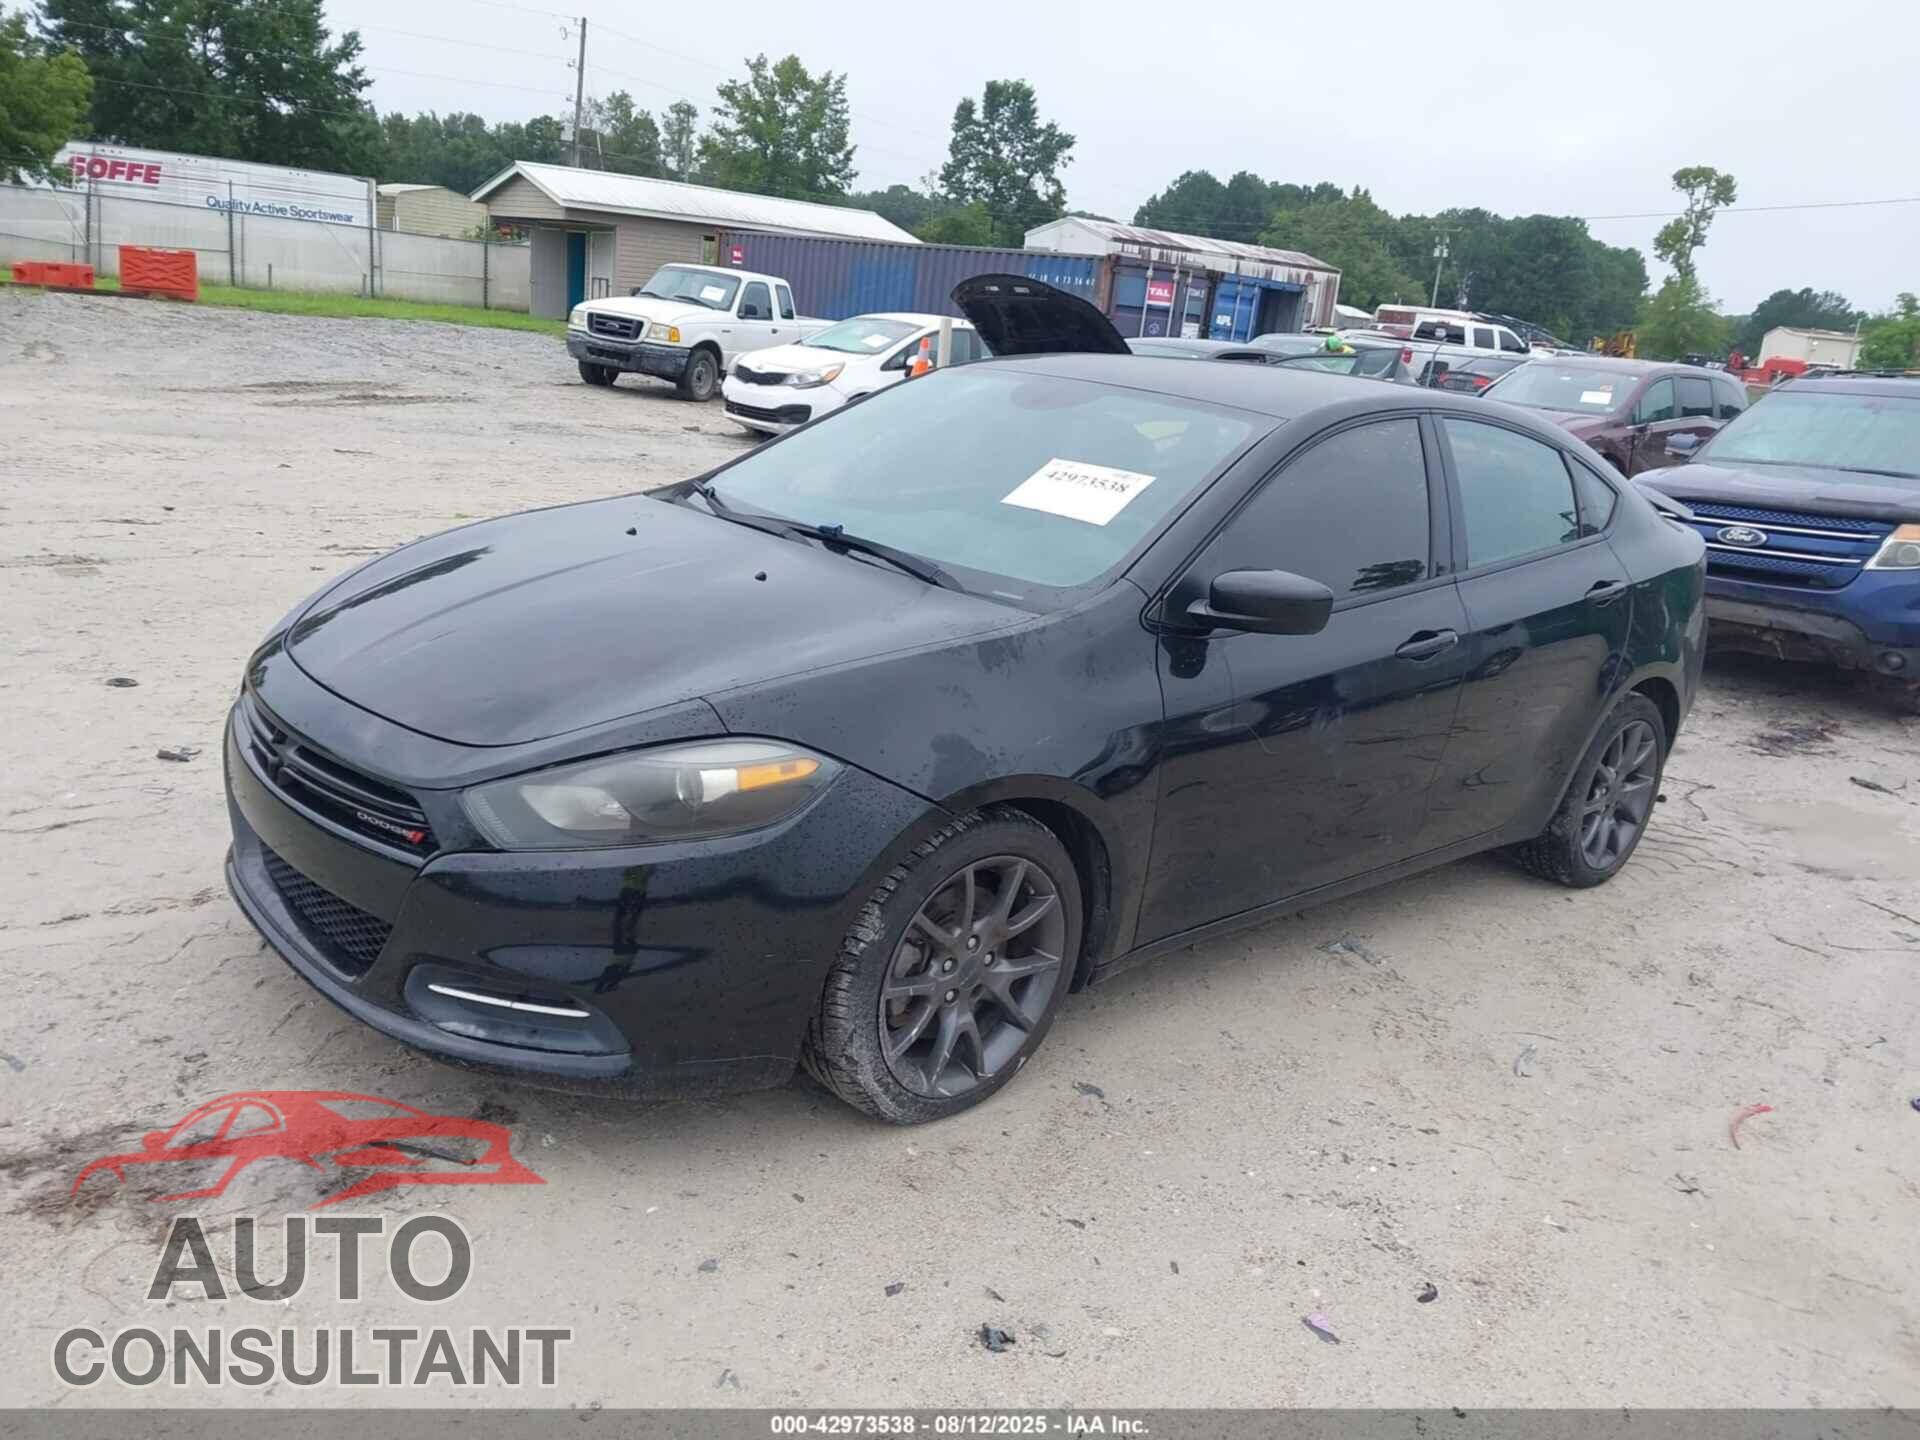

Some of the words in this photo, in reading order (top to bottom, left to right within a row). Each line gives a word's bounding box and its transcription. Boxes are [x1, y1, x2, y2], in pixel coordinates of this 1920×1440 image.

[69, 156, 161, 184] SOFFE
[206, 196, 250, 213] Quality
[252, 204, 288, 216] Active
[290, 206, 354, 222] Sportswear
[1149, 287, 1170, 297] TAL
[1046, 471, 1129, 492] 42973538
[1726, 528, 1753, 541] Ford
[357, 811, 411, 838] DODGE
